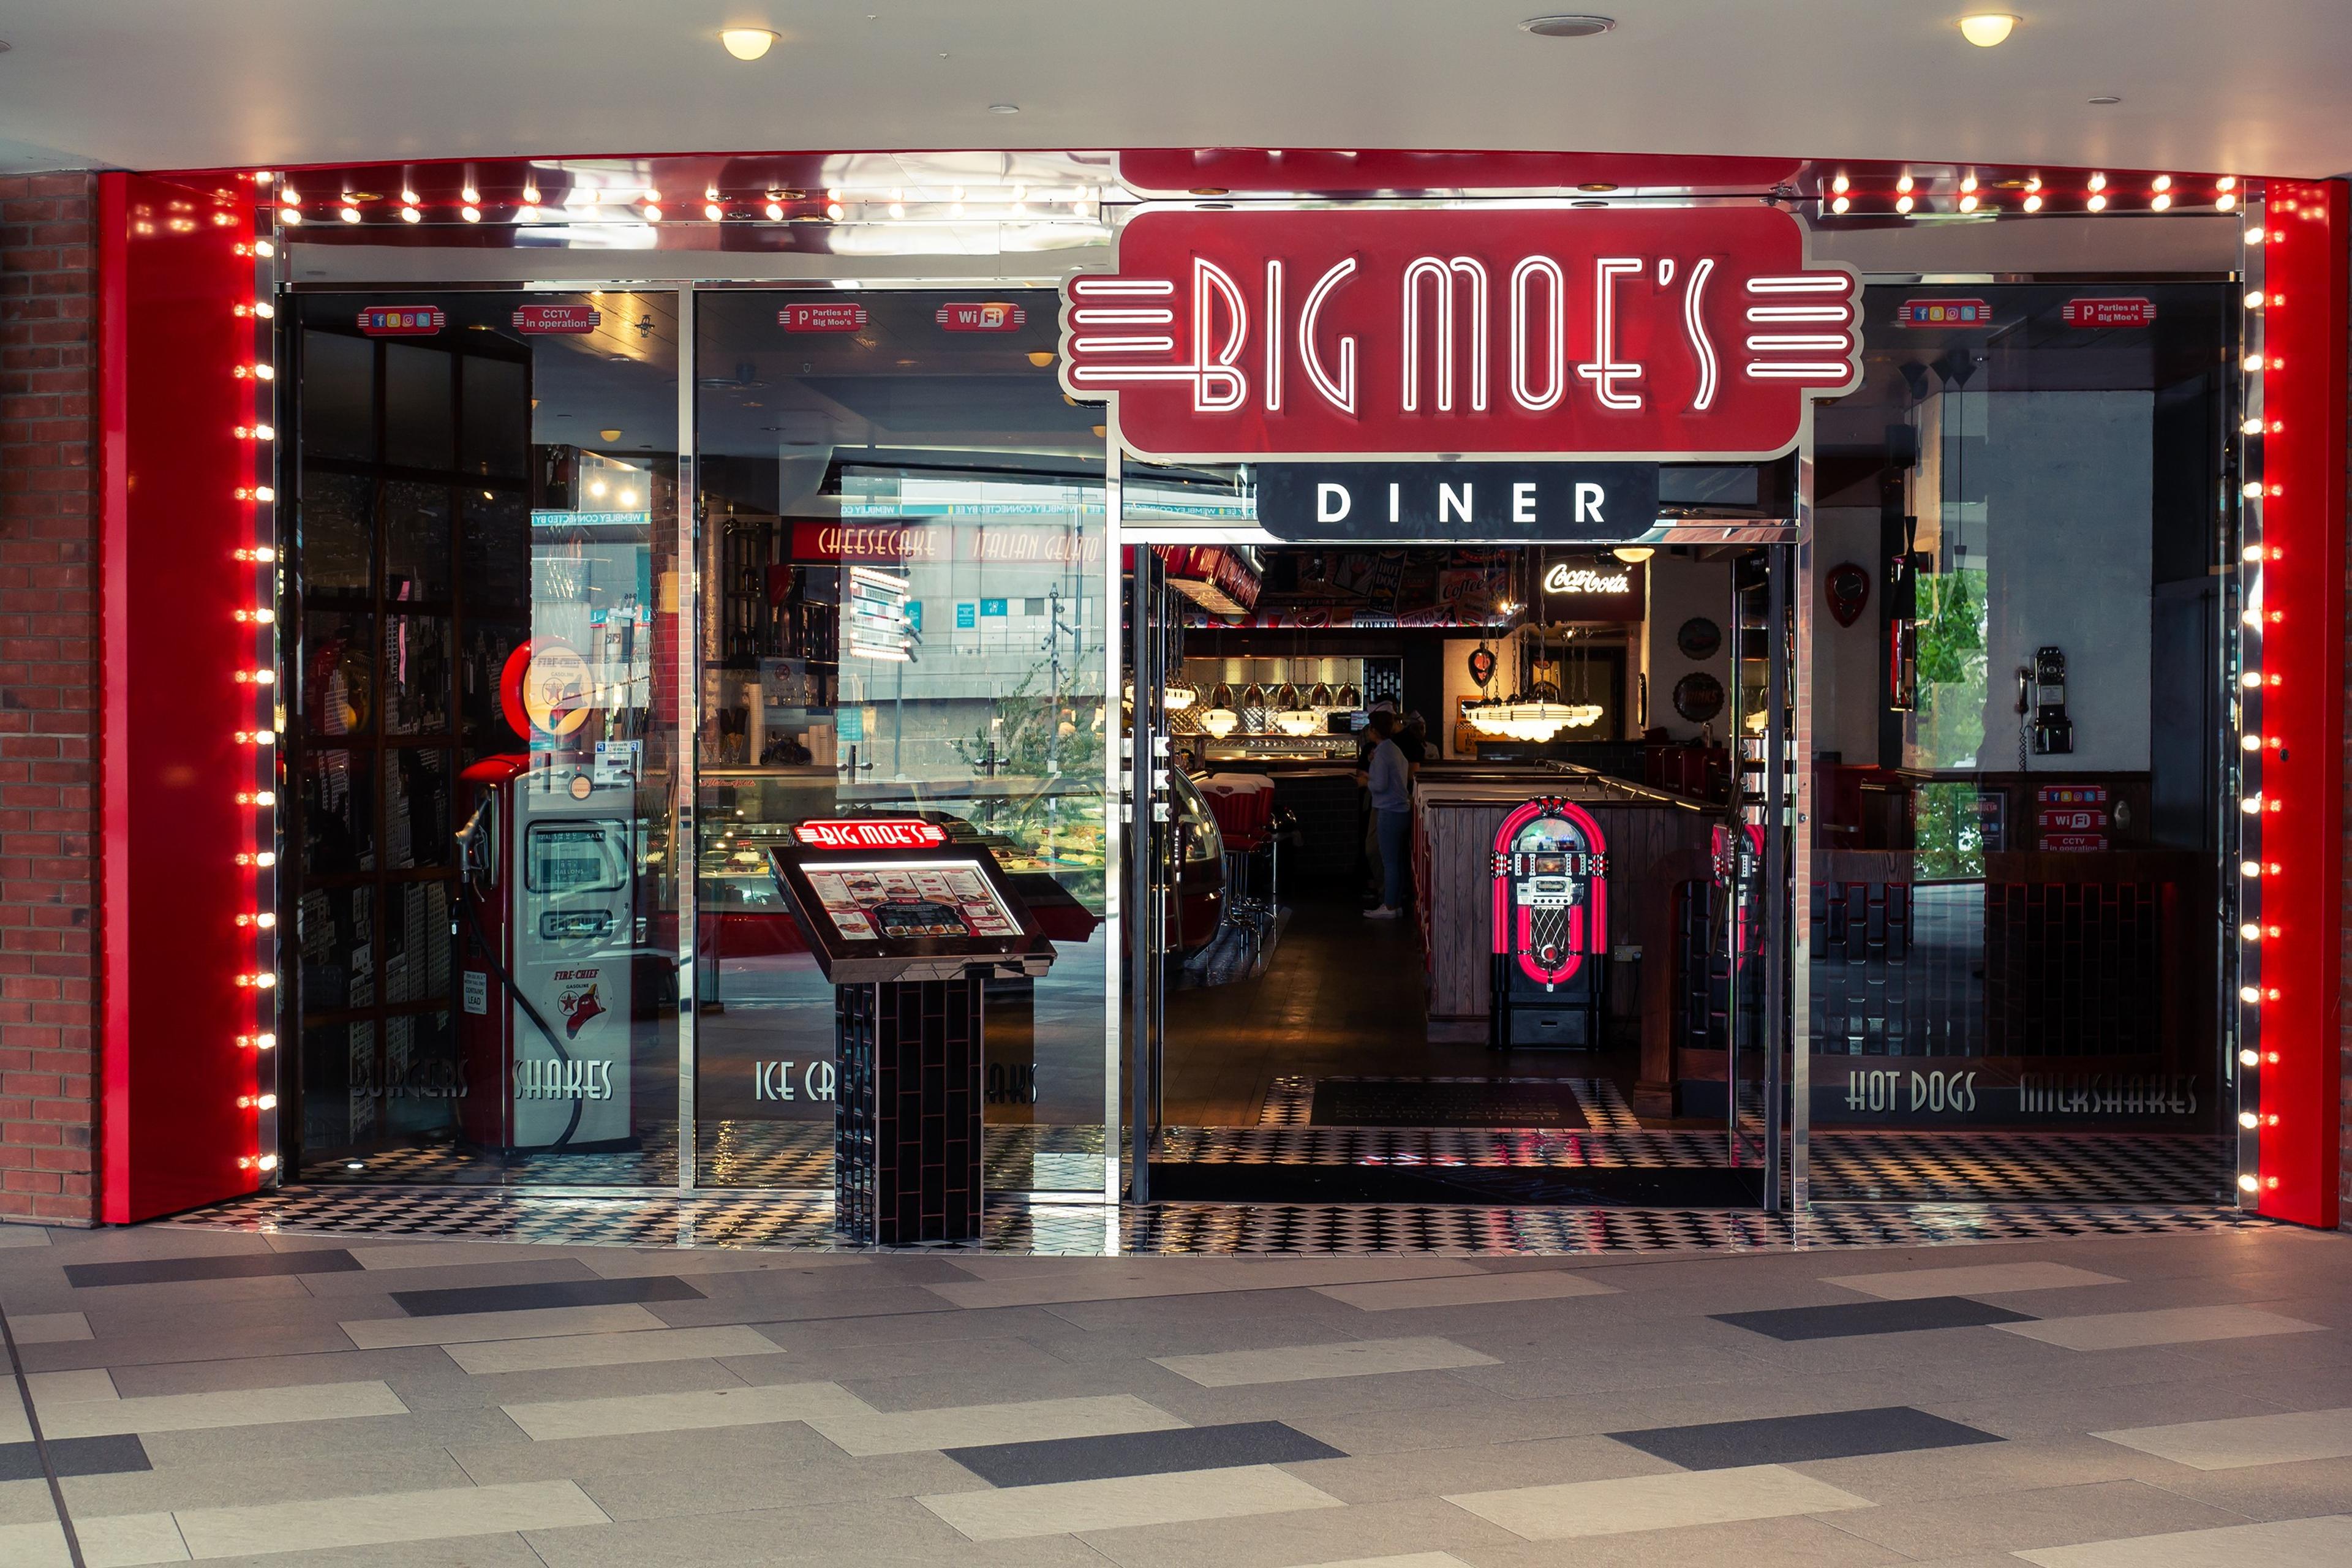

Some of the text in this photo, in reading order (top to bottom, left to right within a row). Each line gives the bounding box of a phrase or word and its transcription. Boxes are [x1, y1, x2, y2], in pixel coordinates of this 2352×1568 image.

[526, 318, 587, 330] in operation
[542, 309, 571, 318] CCTV
[812, 318, 852, 327] Big Moe's
[2098, 314, 2112, 322] Big
[1193, 253, 1717, 418] BIG MOE'S
[1317, 482, 1608, 524] DINER
[818, 527, 937, 556] CHEESECAKE
[973, 532, 1099, 562] ITALIAN GELATO
[1378, 562, 1402, 576] HOT
[1376, 573, 1398, 589] DOG
[1443, 578, 1484, 600] Coffee
[817, 825, 925, 845] BIG MOE'S
[554, 969, 600, 981] FIRE-CHIEF
[468, 996, 481, 1005] LEAD
[347, 1058, 469, 1098] BURGERS
[513, 1059, 612, 1099] SHAKES
[756, 1060, 835, 1101] ICE CR
[1845, 1070, 1977, 1112] HOT DOGS
[2020, 1072, 2198, 1114] MILKSHAKES
